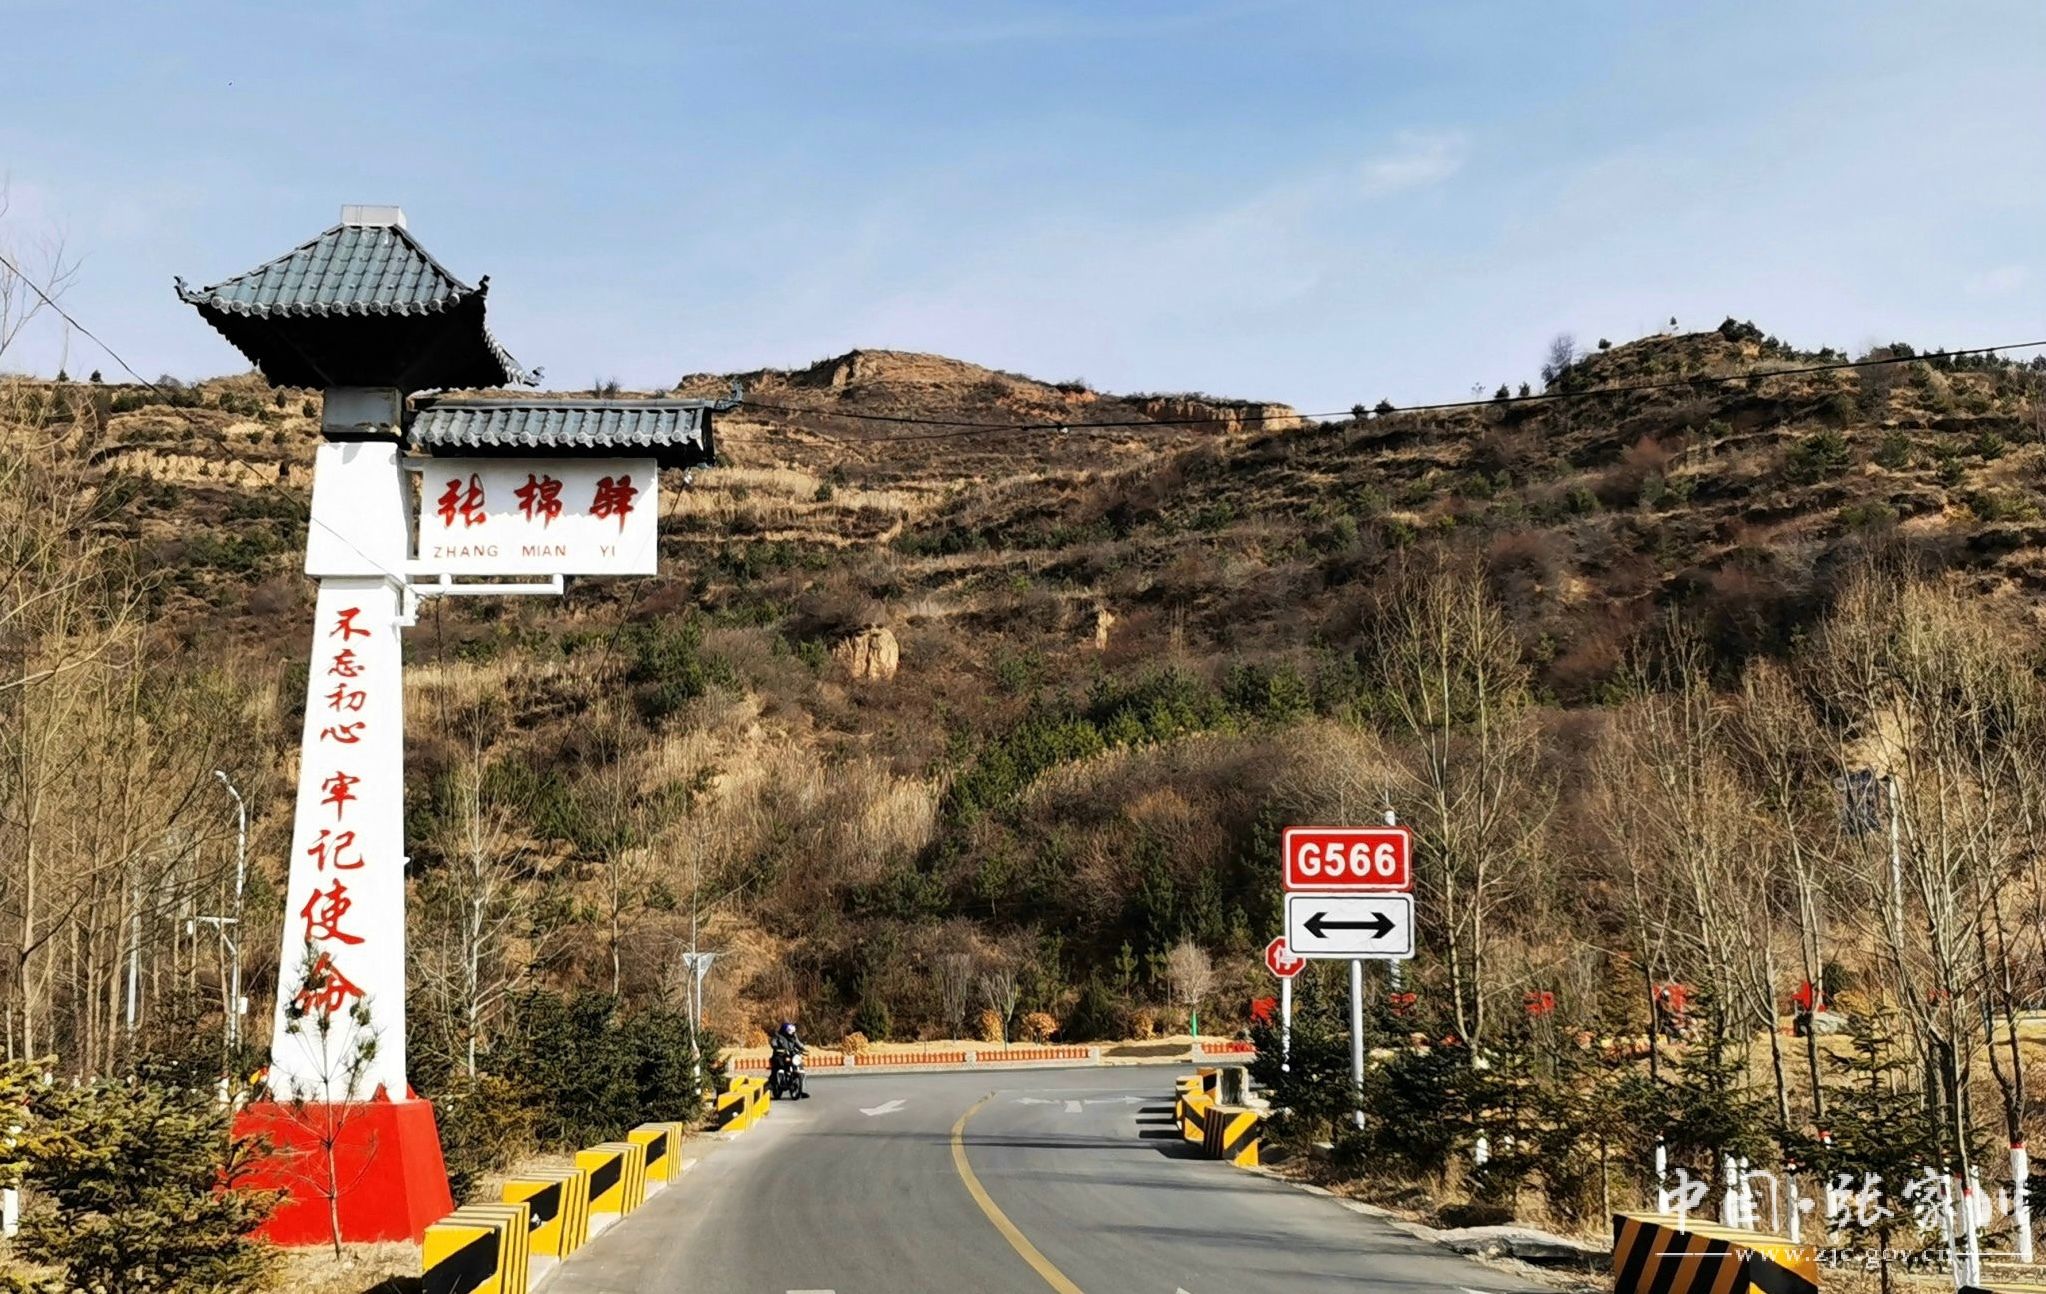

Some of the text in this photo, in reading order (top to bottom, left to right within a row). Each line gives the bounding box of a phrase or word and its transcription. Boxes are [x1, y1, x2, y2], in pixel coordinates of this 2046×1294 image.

[437, 472, 639, 535] 张棉驿
[433, 544, 616, 559] ZHANG MIAN YI
[295, 606, 371, 1018] 不忘初心 牢记使命
[1298, 842, 1397, 877] G566
